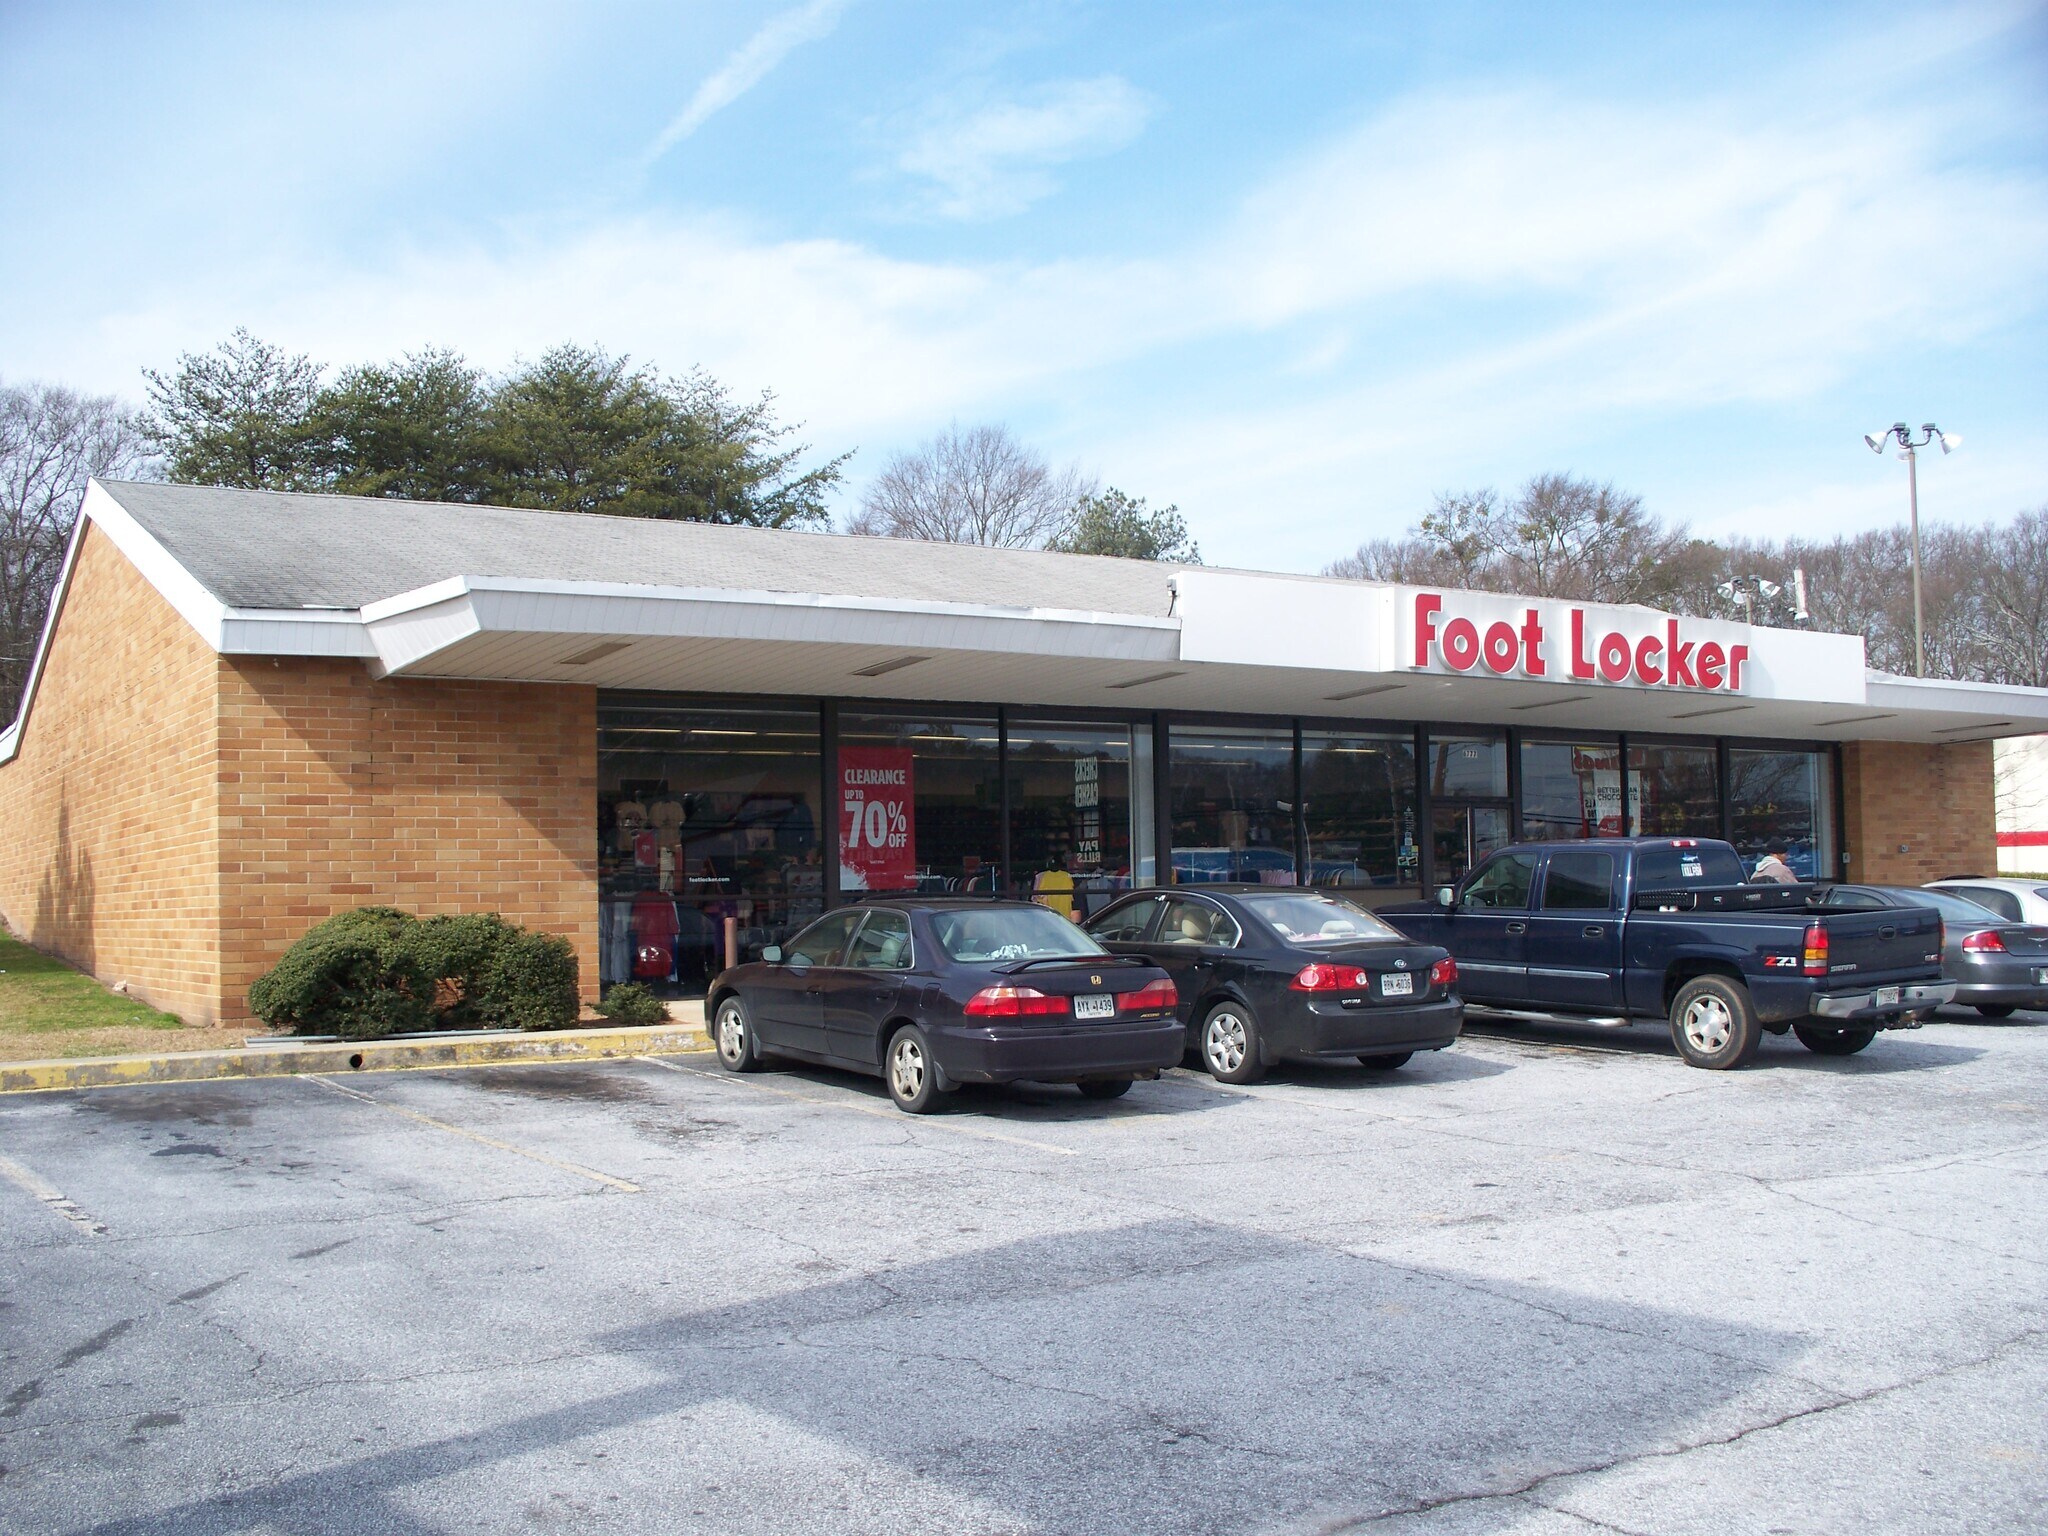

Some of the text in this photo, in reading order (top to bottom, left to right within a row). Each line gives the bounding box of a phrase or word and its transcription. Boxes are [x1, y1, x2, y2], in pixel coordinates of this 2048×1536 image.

[1415, 593, 1748, 690] Foot Locker
[844, 769, 906, 785] CLEARANCE
[844, 789, 864, 800] UP TO
[1597, 793, 1638, 801] CHOCOTE
[844, 800, 907, 848] 70%
[888, 833, 908, 848] OFF
[1764, 956, 1797, 967] Z71
[1830, 963, 1857, 973] SIERRA
[1077, 999, 1112, 1013] AYX 1439
